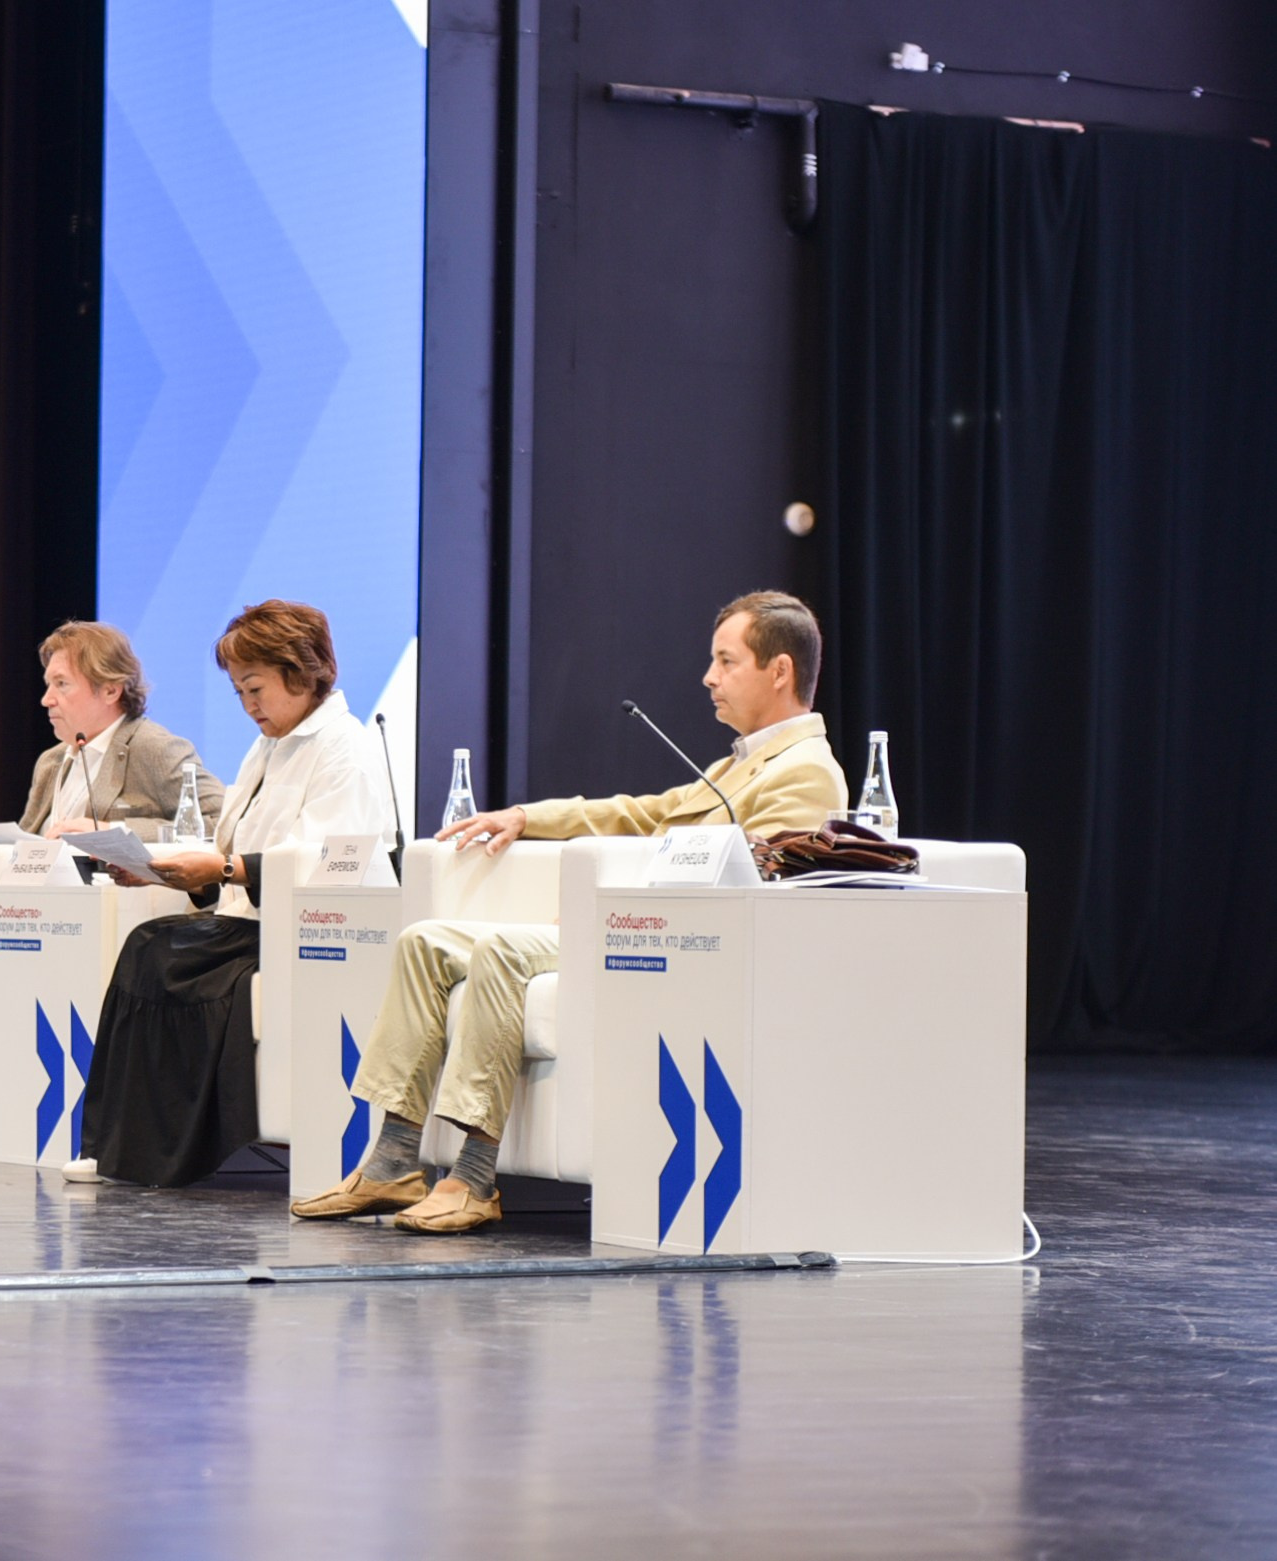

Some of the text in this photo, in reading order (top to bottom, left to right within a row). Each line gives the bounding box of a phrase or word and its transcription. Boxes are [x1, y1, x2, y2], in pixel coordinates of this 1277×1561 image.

[670, 851, 710, 865] КУЗНЕЦОВ
[299, 909, 347, 925] «Сообщество»
[606, 912, 668, 931] «Сообщество»
[15, 922, 26, 933] для
[40, 923, 50, 932] кто
[51, 921, 82, 935] действует
[299, 927, 319, 941] форум
[320, 928, 331, 940] для
[344, 929, 355, 939] кто
[356, 927, 388, 944] действует
[605, 932, 721, 951] форум для тех, кто действует
[608, 957, 664, 970] #форумсообщество
